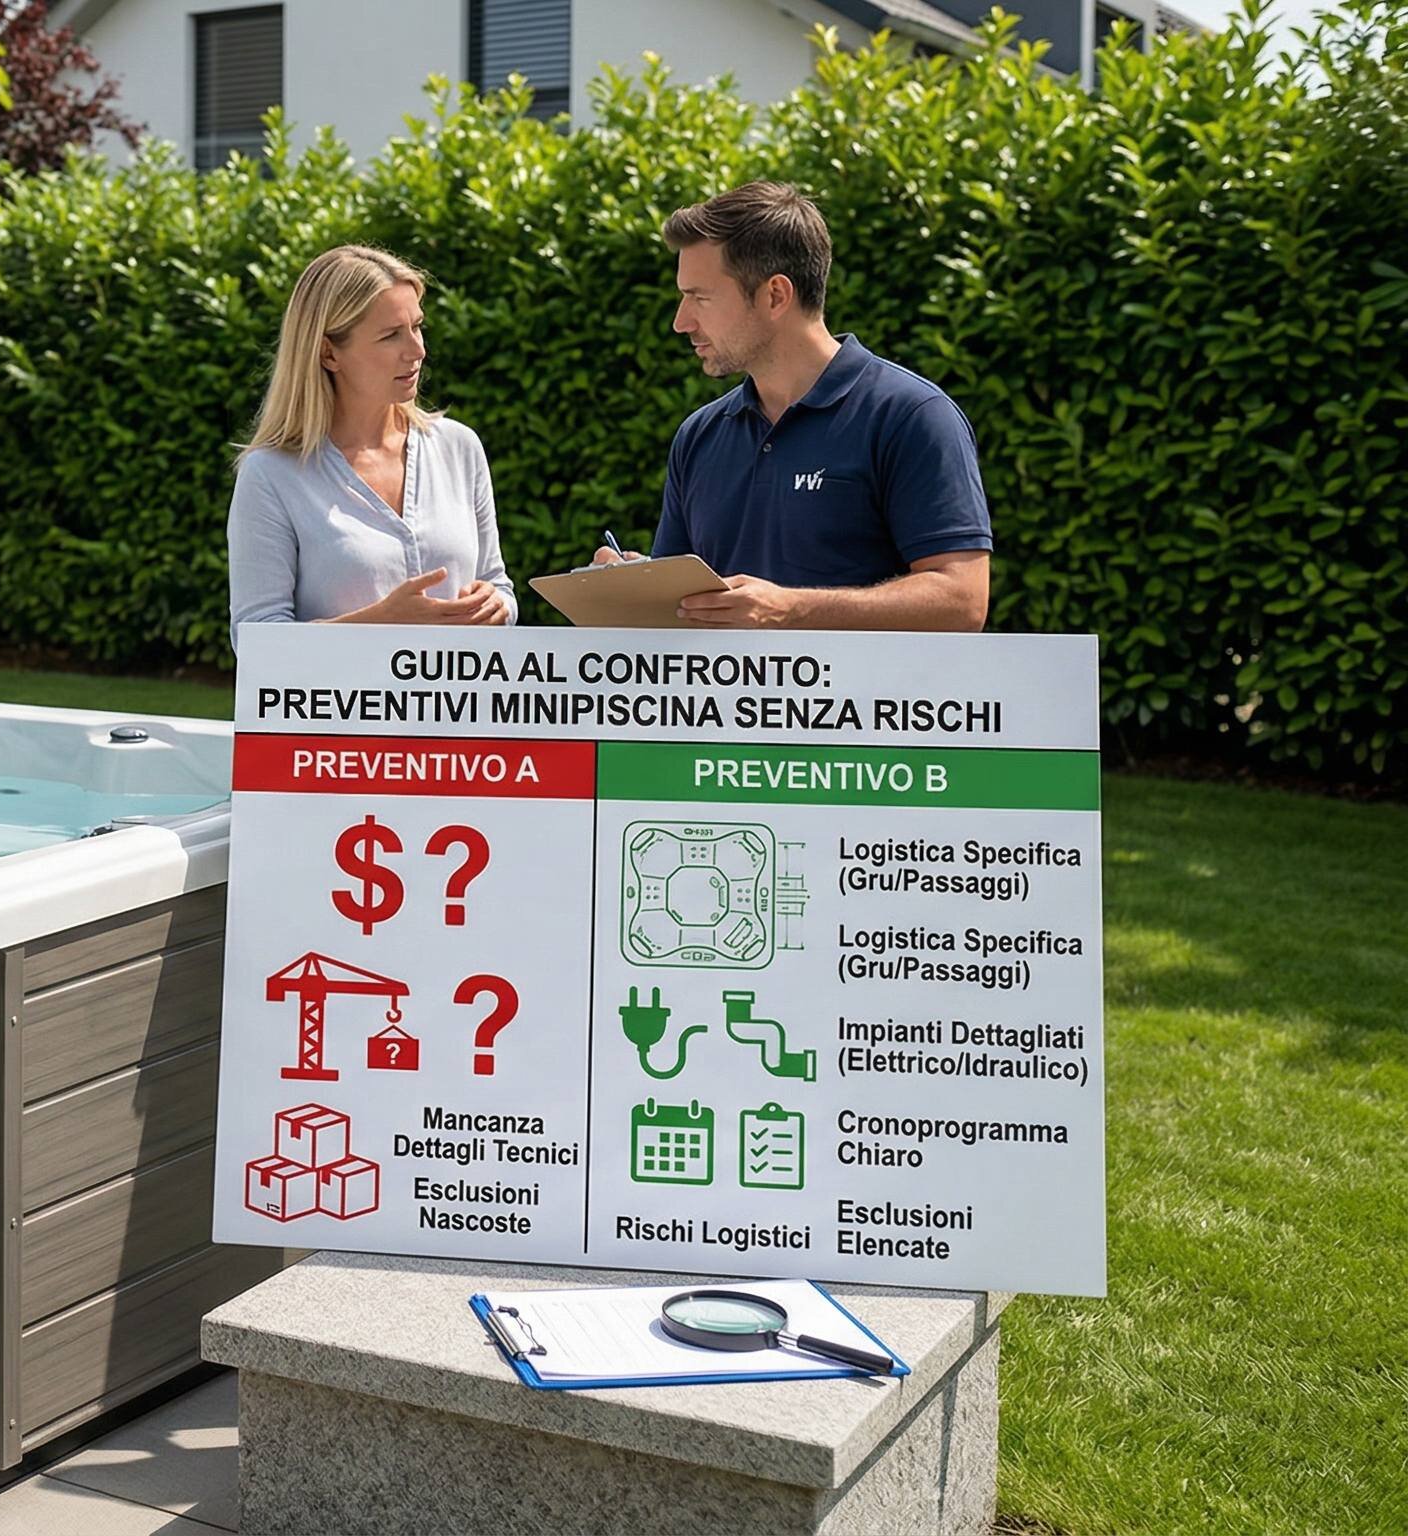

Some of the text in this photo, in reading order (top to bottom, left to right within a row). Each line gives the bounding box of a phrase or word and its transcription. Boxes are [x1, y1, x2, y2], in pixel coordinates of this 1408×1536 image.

[390, 649, 831, 688] GUIDA AL CONFRONTO:
[258, 687, 1001, 733] PREVENTIVI MINIPISCINA SENZA RISCHI
[293, 750, 539, 783] PREVENTIVO A
[695, 759, 948, 792] PREVENTIVO B
[839, 836, 1082, 870] Logistica Specifica
[331, 814, 491, 936] $ ?
[838, 866, 1029, 902] (Gru/Passaggi)
[839, 924, 1083, 959] Logistica Specifica
[838, 953, 1031, 991] (Gru/Passaggi)
[453, 974, 520, 1077] ?
[838, 1016, 1084, 1053] Impianti Dettagliati
[386, 1043, 401, 1065] ?
[838, 1047, 1089, 1086] (Elettrico/Idraulico)
[423, 1106, 545, 1135] Mancanza
[837, 1109, 1069, 1146] Cronoprogramma
[393, 1134, 579, 1166] Dettagli Tecnici
[837, 1140, 923, 1168] Chiaro
[414, 1176, 539, 1206] Esclusioni
[419, 1205, 532, 1235] Nascoste
[837, 1199, 973, 1230] Esclusioni
[616, 1215, 811, 1252] Rischi Logistici
[837, 1229, 950, 1260] Elencate
